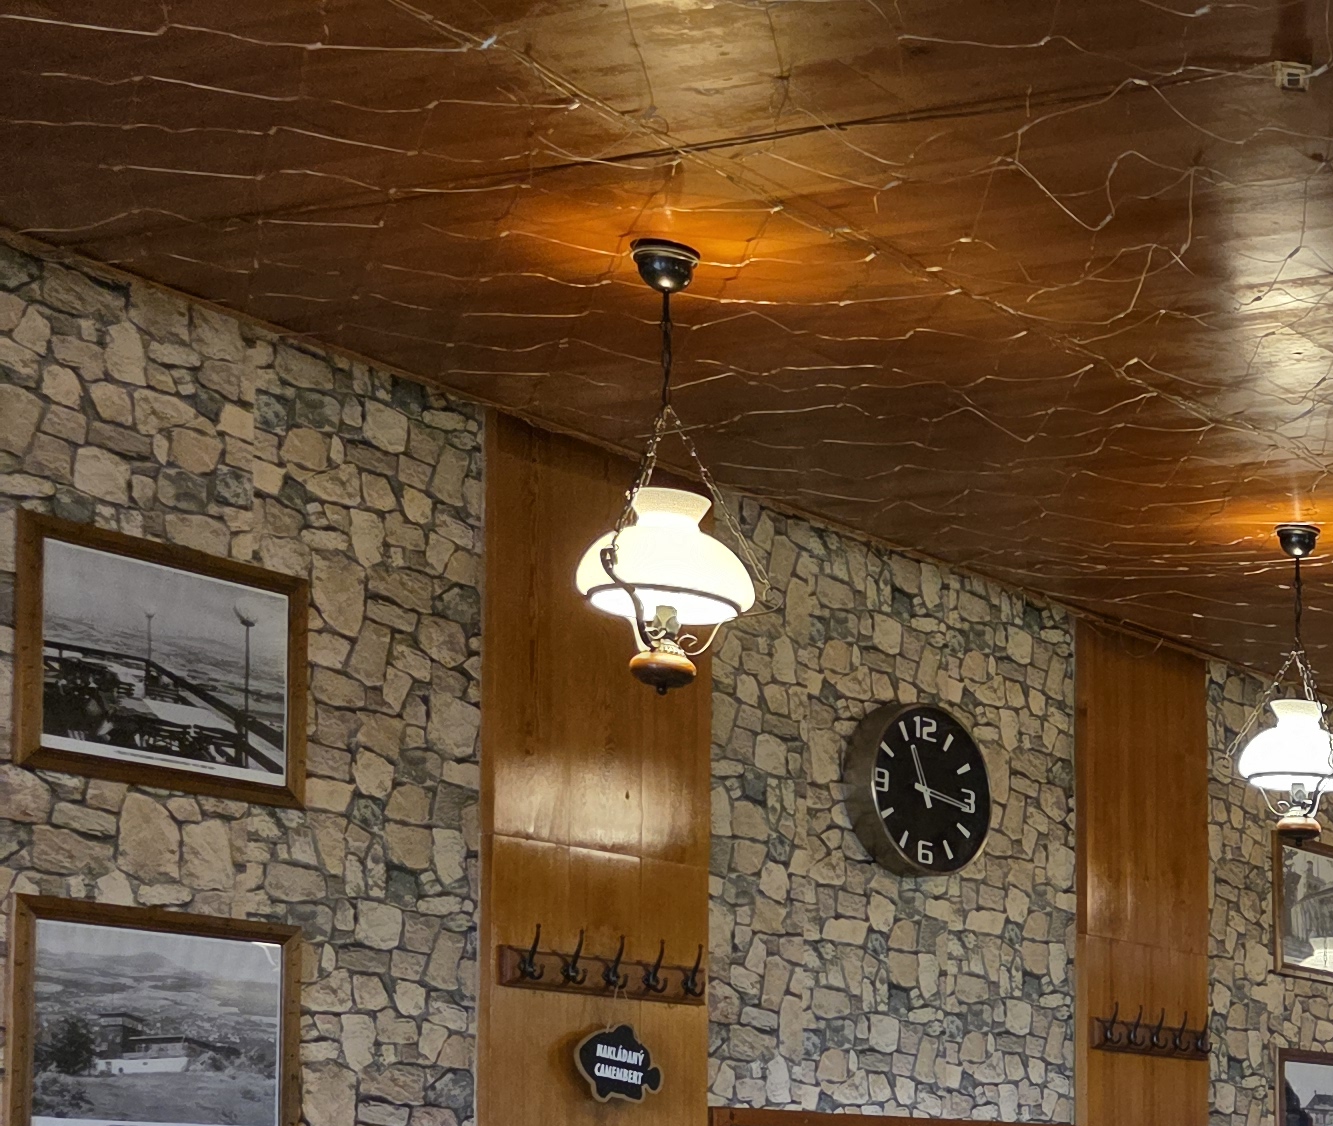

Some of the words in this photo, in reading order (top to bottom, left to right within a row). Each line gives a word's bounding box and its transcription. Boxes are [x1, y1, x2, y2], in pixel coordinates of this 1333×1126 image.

[913, 715, 938, 743] 12
[874, 767, 890, 792] 9
[960, 788, 976, 815] 3
[917, 840, 934, 865] 6
[596, 1044, 645, 1066] NAKLÁDANÝ
[594, 1063, 644, 1084] CAMEMBERT
